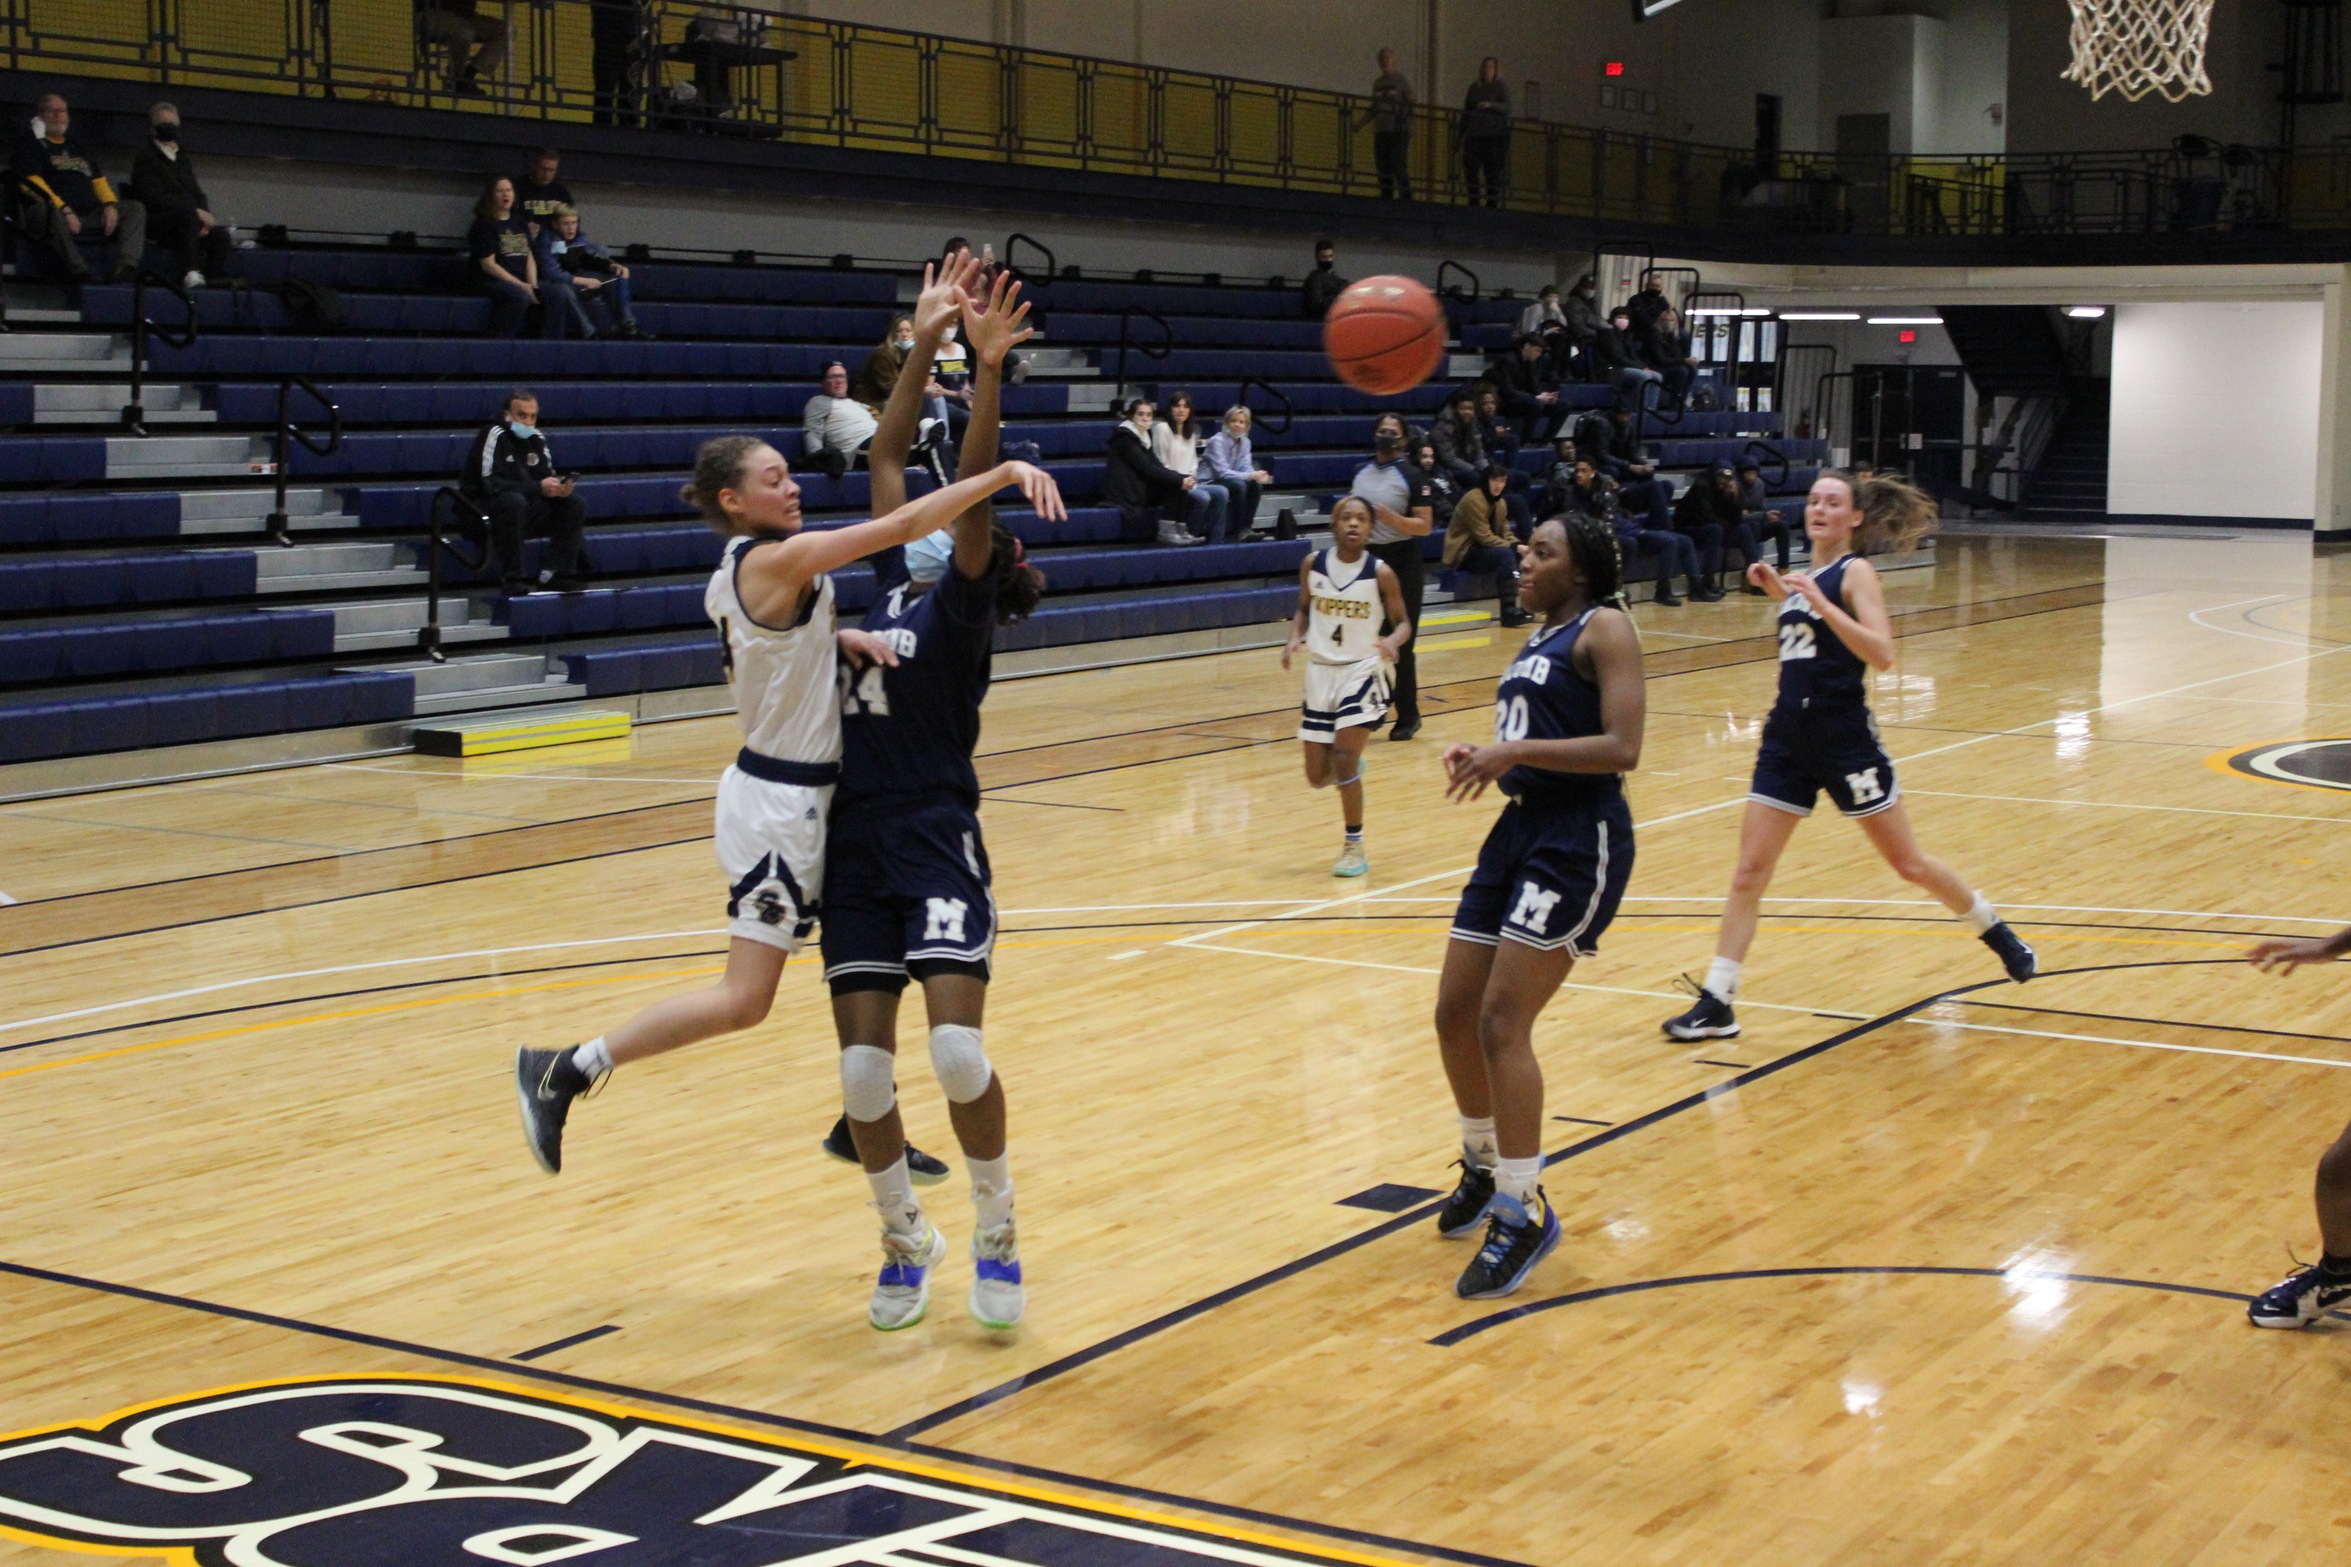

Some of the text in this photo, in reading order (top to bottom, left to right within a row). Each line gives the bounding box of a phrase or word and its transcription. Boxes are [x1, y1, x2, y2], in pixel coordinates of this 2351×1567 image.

[1331, 624, 1344, 647] 4
[1779, 622, 1817, 662] 22
[1845, 767, 1885, 806] M
[923, 897, 968, 943] M
[1509, 881, 1562, 935] M
